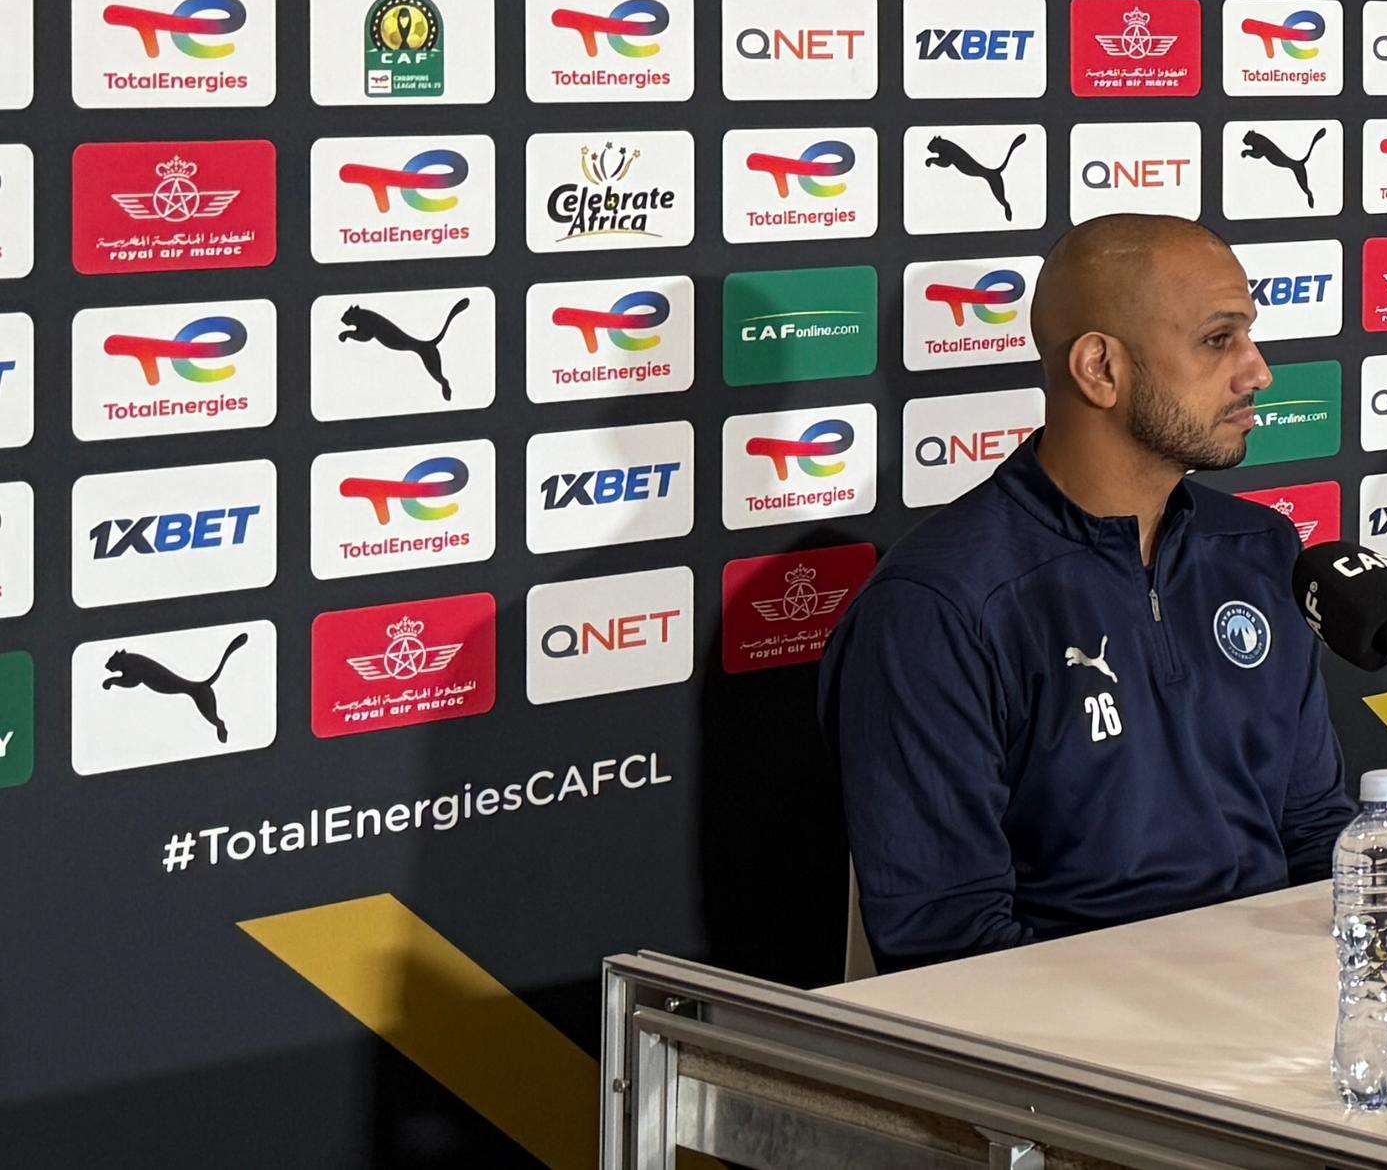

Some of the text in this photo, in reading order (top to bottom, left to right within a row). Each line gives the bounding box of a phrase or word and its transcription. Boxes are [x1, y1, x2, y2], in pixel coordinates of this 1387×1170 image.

[736, 28, 865, 60] QNET
[916, 29, 1035, 60] 1XBET
[381, 52, 428, 64] CAF
[104, 72, 247, 93] TotalEnergies
[552, 69, 670, 89] TotalEnergies
[1242, 69, 1326, 85] TotalEnergies
[1082, 159, 1190, 189] QNET
[547, 185, 674, 222] Celebrate
[569, 211, 647, 236] Africa
[747, 208, 855, 226] TotalEnergies
[339, 224, 469, 244] TotalEnergies
[109, 246, 242, 261] royal air maroc
[1247, 273, 1333, 307] XBET
[925, 334, 1025, 354] TotalEnergies
[552, 361, 671, 384] TotalEnergies
[103, 394, 248, 420] TotalEnergies
[541, 462, 681, 510] 1XBET
[746, 486, 855, 512] TotalEnergies
[90, 505, 260, 560] 1XBET
[339, 530, 470, 559] TotalEnergies
[541, 610, 680, 658] QNET
[749, 647, 782, 659] royal
[787, 644, 806, 653] air
[344, 696, 464, 722] royal air maroc
[1083, 691, 1122, 743] 26
[162, 752, 672, 873] #TotalEnergiesCAFCL
